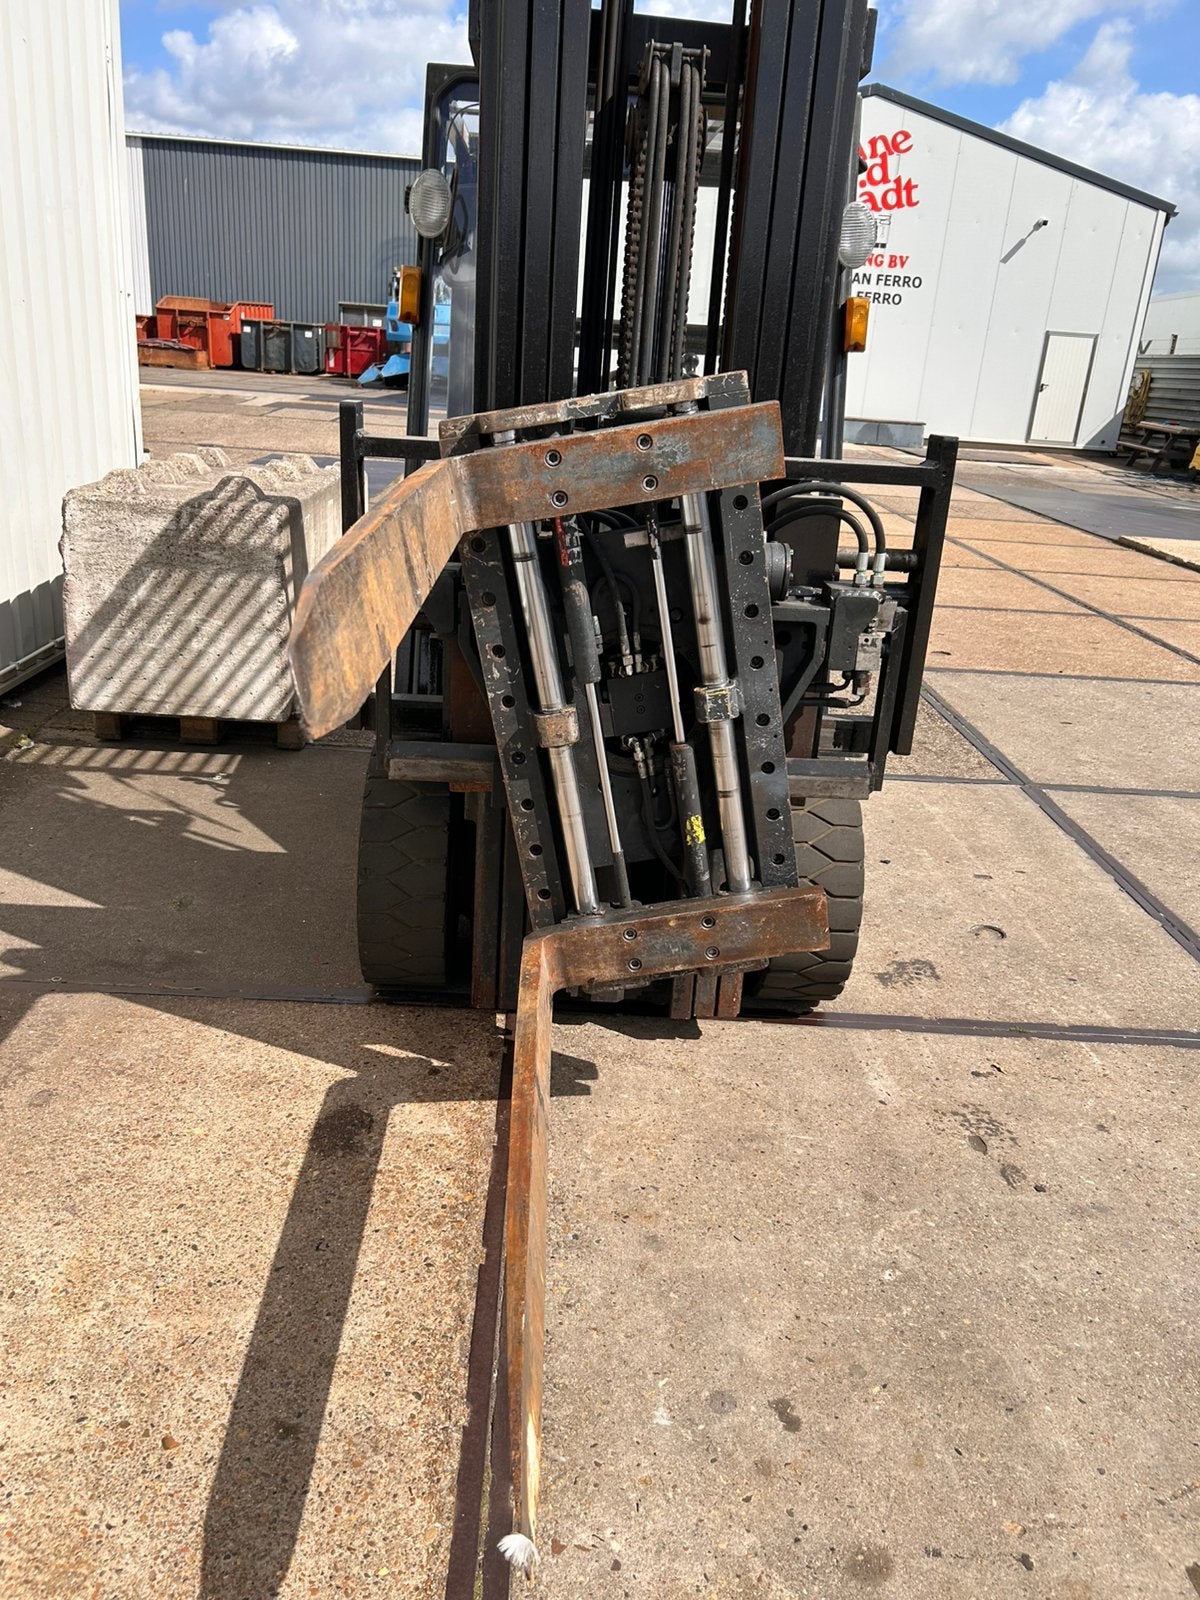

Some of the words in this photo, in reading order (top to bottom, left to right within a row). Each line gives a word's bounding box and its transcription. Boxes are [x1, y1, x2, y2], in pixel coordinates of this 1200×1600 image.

[858, 130, 913, 160] ne
[888, 255, 910, 269] BV
[852, 273, 872, 285] AN
[876, 274, 923, 289] FERRO
